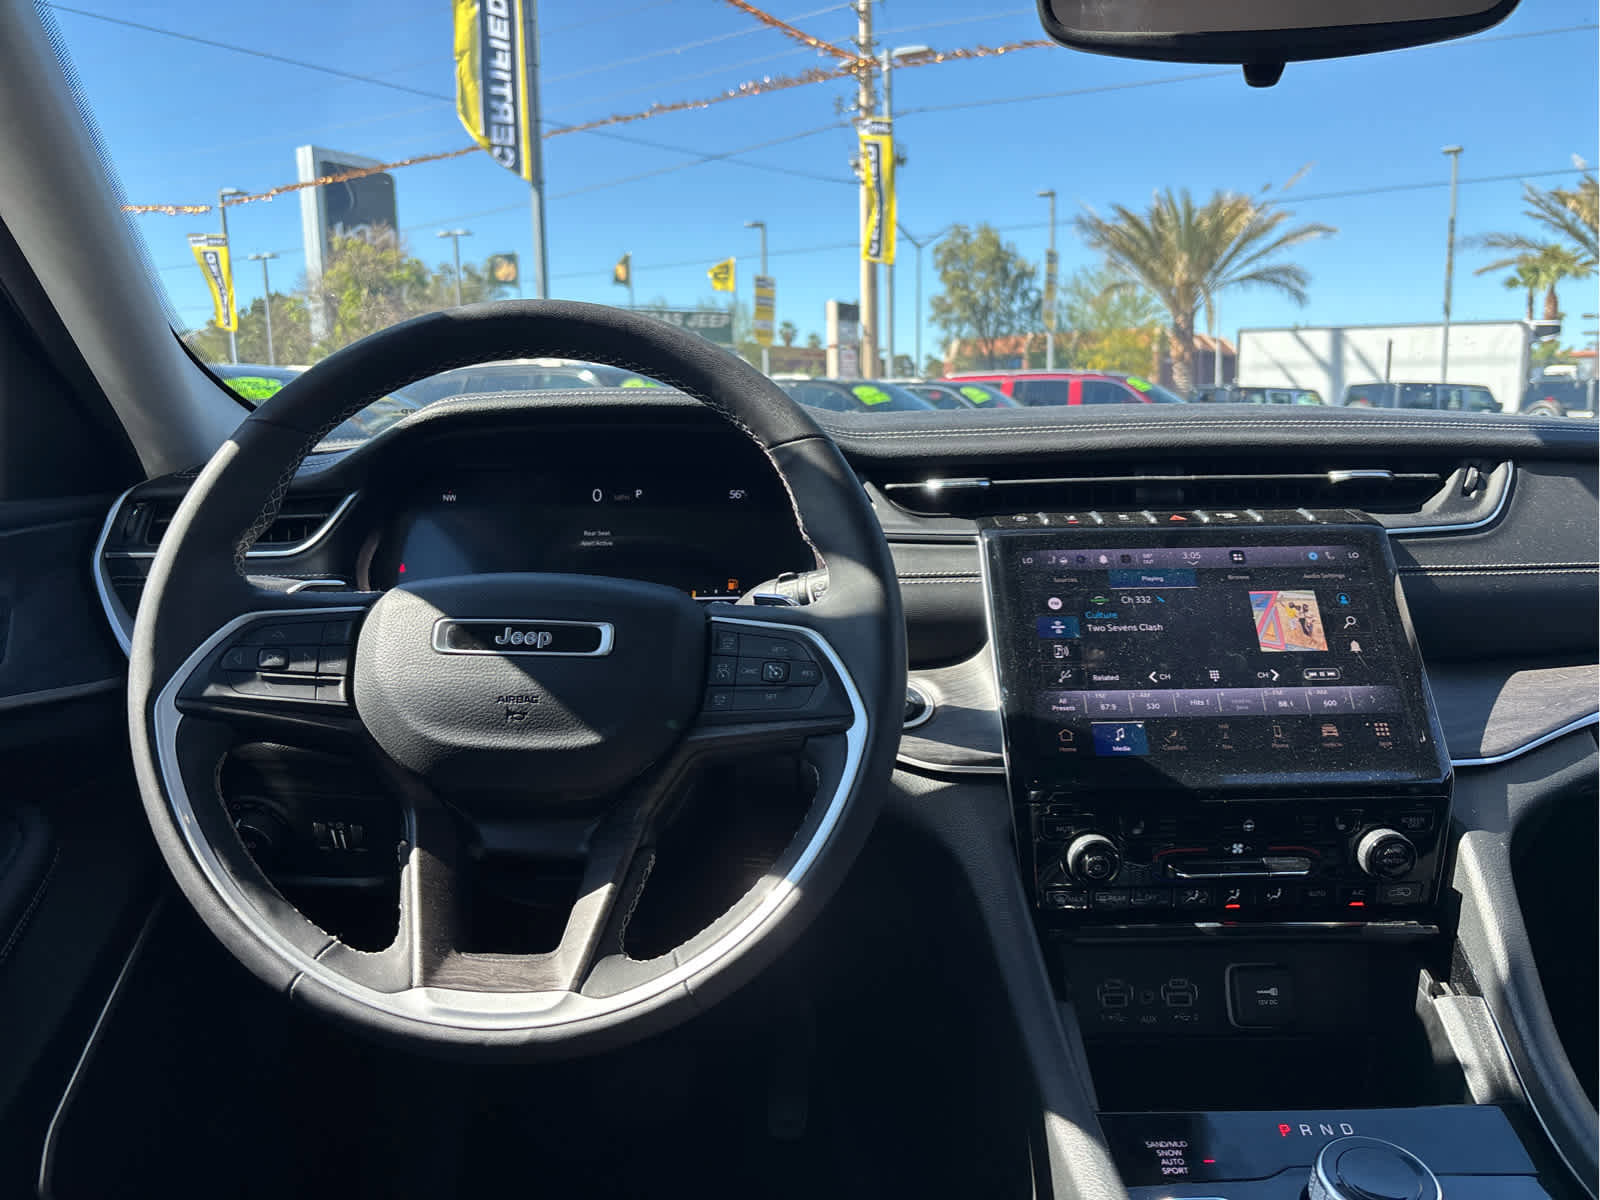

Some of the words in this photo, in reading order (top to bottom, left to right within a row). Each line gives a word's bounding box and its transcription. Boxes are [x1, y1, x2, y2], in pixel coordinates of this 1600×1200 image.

[442, 493, 457, 502] NW
[592, 488, 603, 503] 0
[635, 489, 643, 498] P
[1182, 552, 1201, 560] 3:05
[1121, 595, 1134, 604] Ch
[1135, 595, 1152, 604] 332
[1085, 611, 1118, 619] Culture
[1087, 623, 1106, 632] Two
[1107, 623, 1138, 632] Sevens
[1138, 623, 1164, 632] Clash
[495, 626, 553, 649] Jeep
[1257, 671, 1269, 679] CH
[496, 695, 540, 704] AIRBAG
[1278, 1123, 1291, 1136] P
[1300, 1123, 1313, 1136] R
[1319, 1123, 1334, 1136] N
[1340, 1123, 1354, 1135] D
[1156, 1149, 1183, 1157] SNOW
[1160, 1158, 1185, 1166] AUTO
[1161, 1166, 1189, 1175] SPORT
